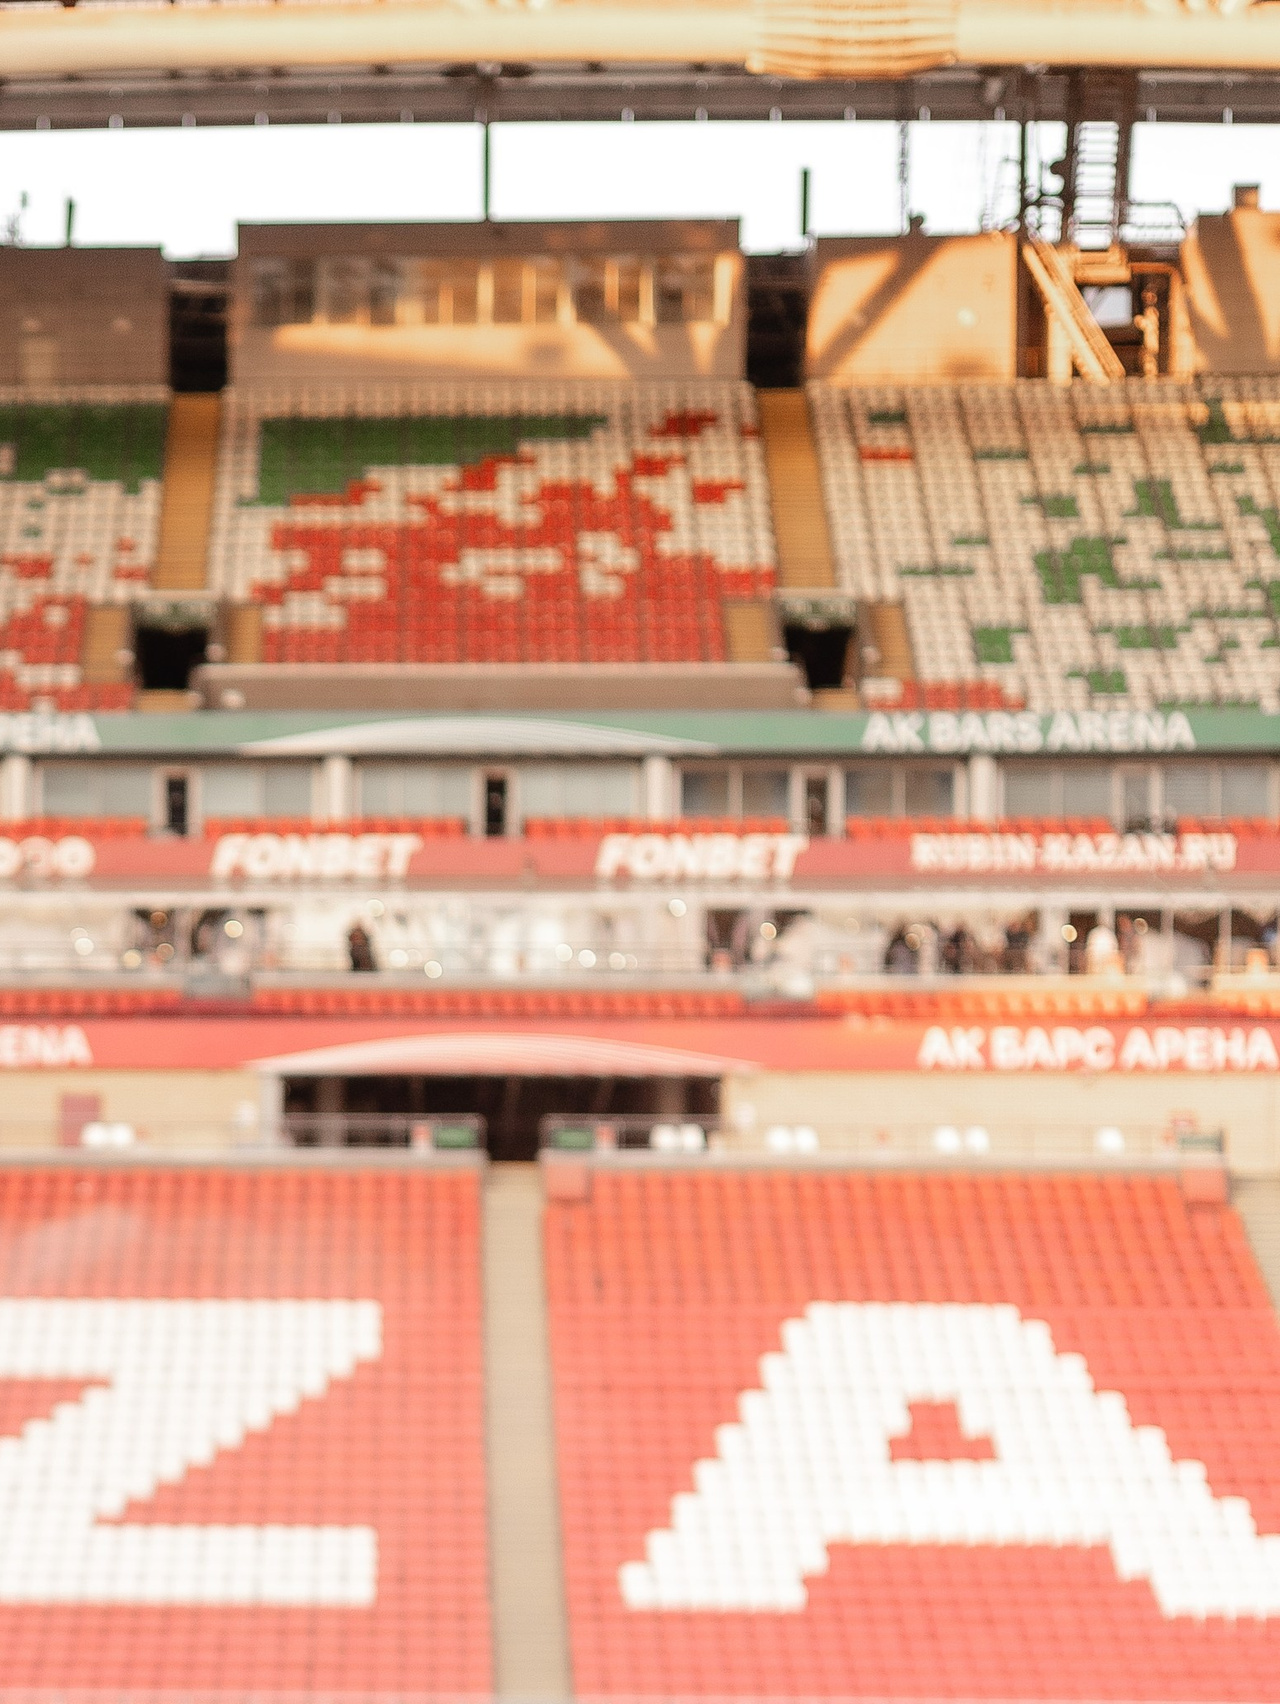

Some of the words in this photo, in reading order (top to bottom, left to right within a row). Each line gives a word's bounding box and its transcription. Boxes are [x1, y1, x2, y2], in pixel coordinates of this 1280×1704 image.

[210, 834, 422, 879] FONBET
[593, 833, 808, 879] FONBET
[989, 1025, 1116, 1071] БАРС
[1119, 1026, 1280, 1072] АРЕНА
